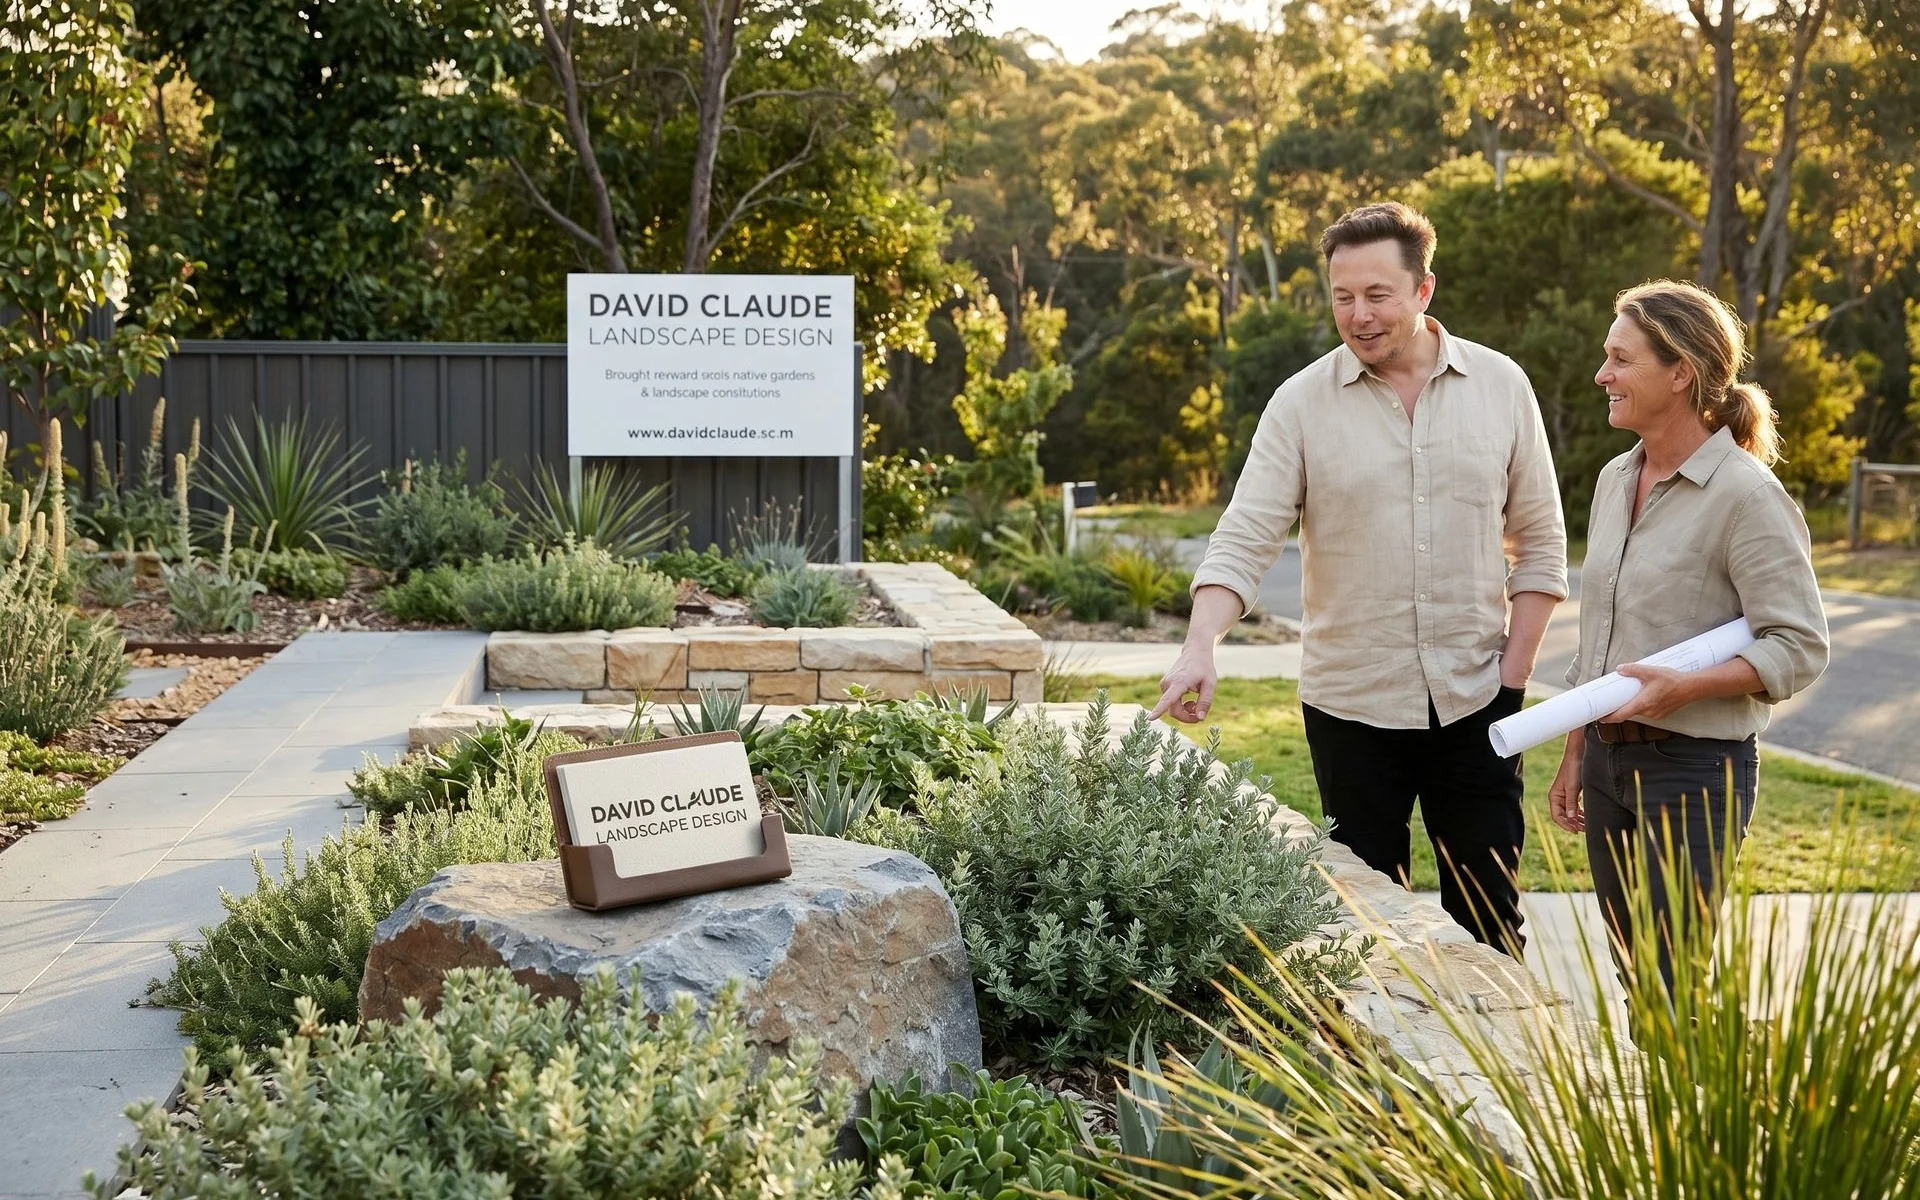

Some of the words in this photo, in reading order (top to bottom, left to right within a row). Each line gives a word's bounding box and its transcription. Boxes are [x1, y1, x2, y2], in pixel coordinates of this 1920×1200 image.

[589, 293, 689, 318] DAVID
[700, 293, 832, 318] CLAUDE
[589, 327, 735, 346] LANDSCAPE
[745, 327, 832, 346] DESIGN
[605, 369, 650, 383] Brought
[733, 369, 767, 381] native
[770, 369, 815, 383] gardens
[640, 387, 649, 398] &
[652, 387, 709, 400] landscape
[628, 426, 794, 439] www.davidclaude.sc.m
[590, 799, 655, 824] DAVID
[660, 785, 744, 813] CLAUDE
[596, 818, 689, 844] LANDSCAPE
[692, 809, 748, 829] DESIGN
